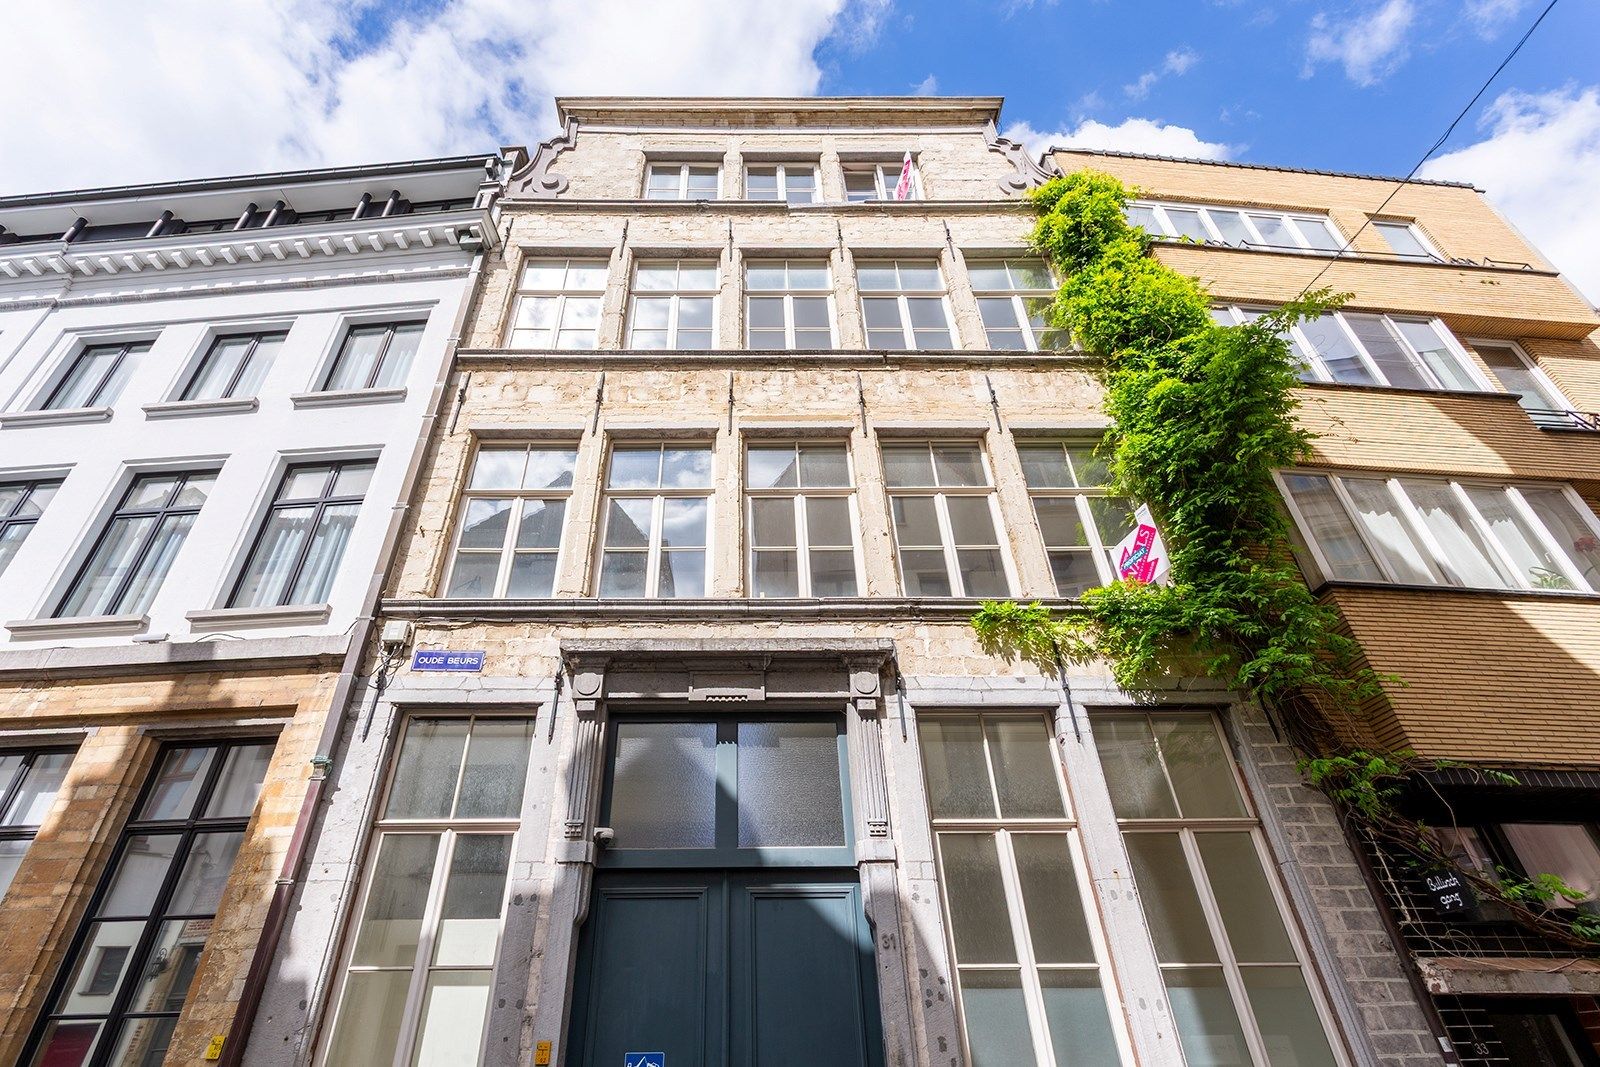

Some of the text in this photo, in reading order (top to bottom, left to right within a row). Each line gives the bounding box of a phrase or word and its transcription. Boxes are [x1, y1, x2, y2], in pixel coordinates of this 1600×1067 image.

[418, 656, 479, 665] OUDE BEURS
[1440, 892, 1463, 909] gang
[1474, 1042, 1490, 1055] 33
